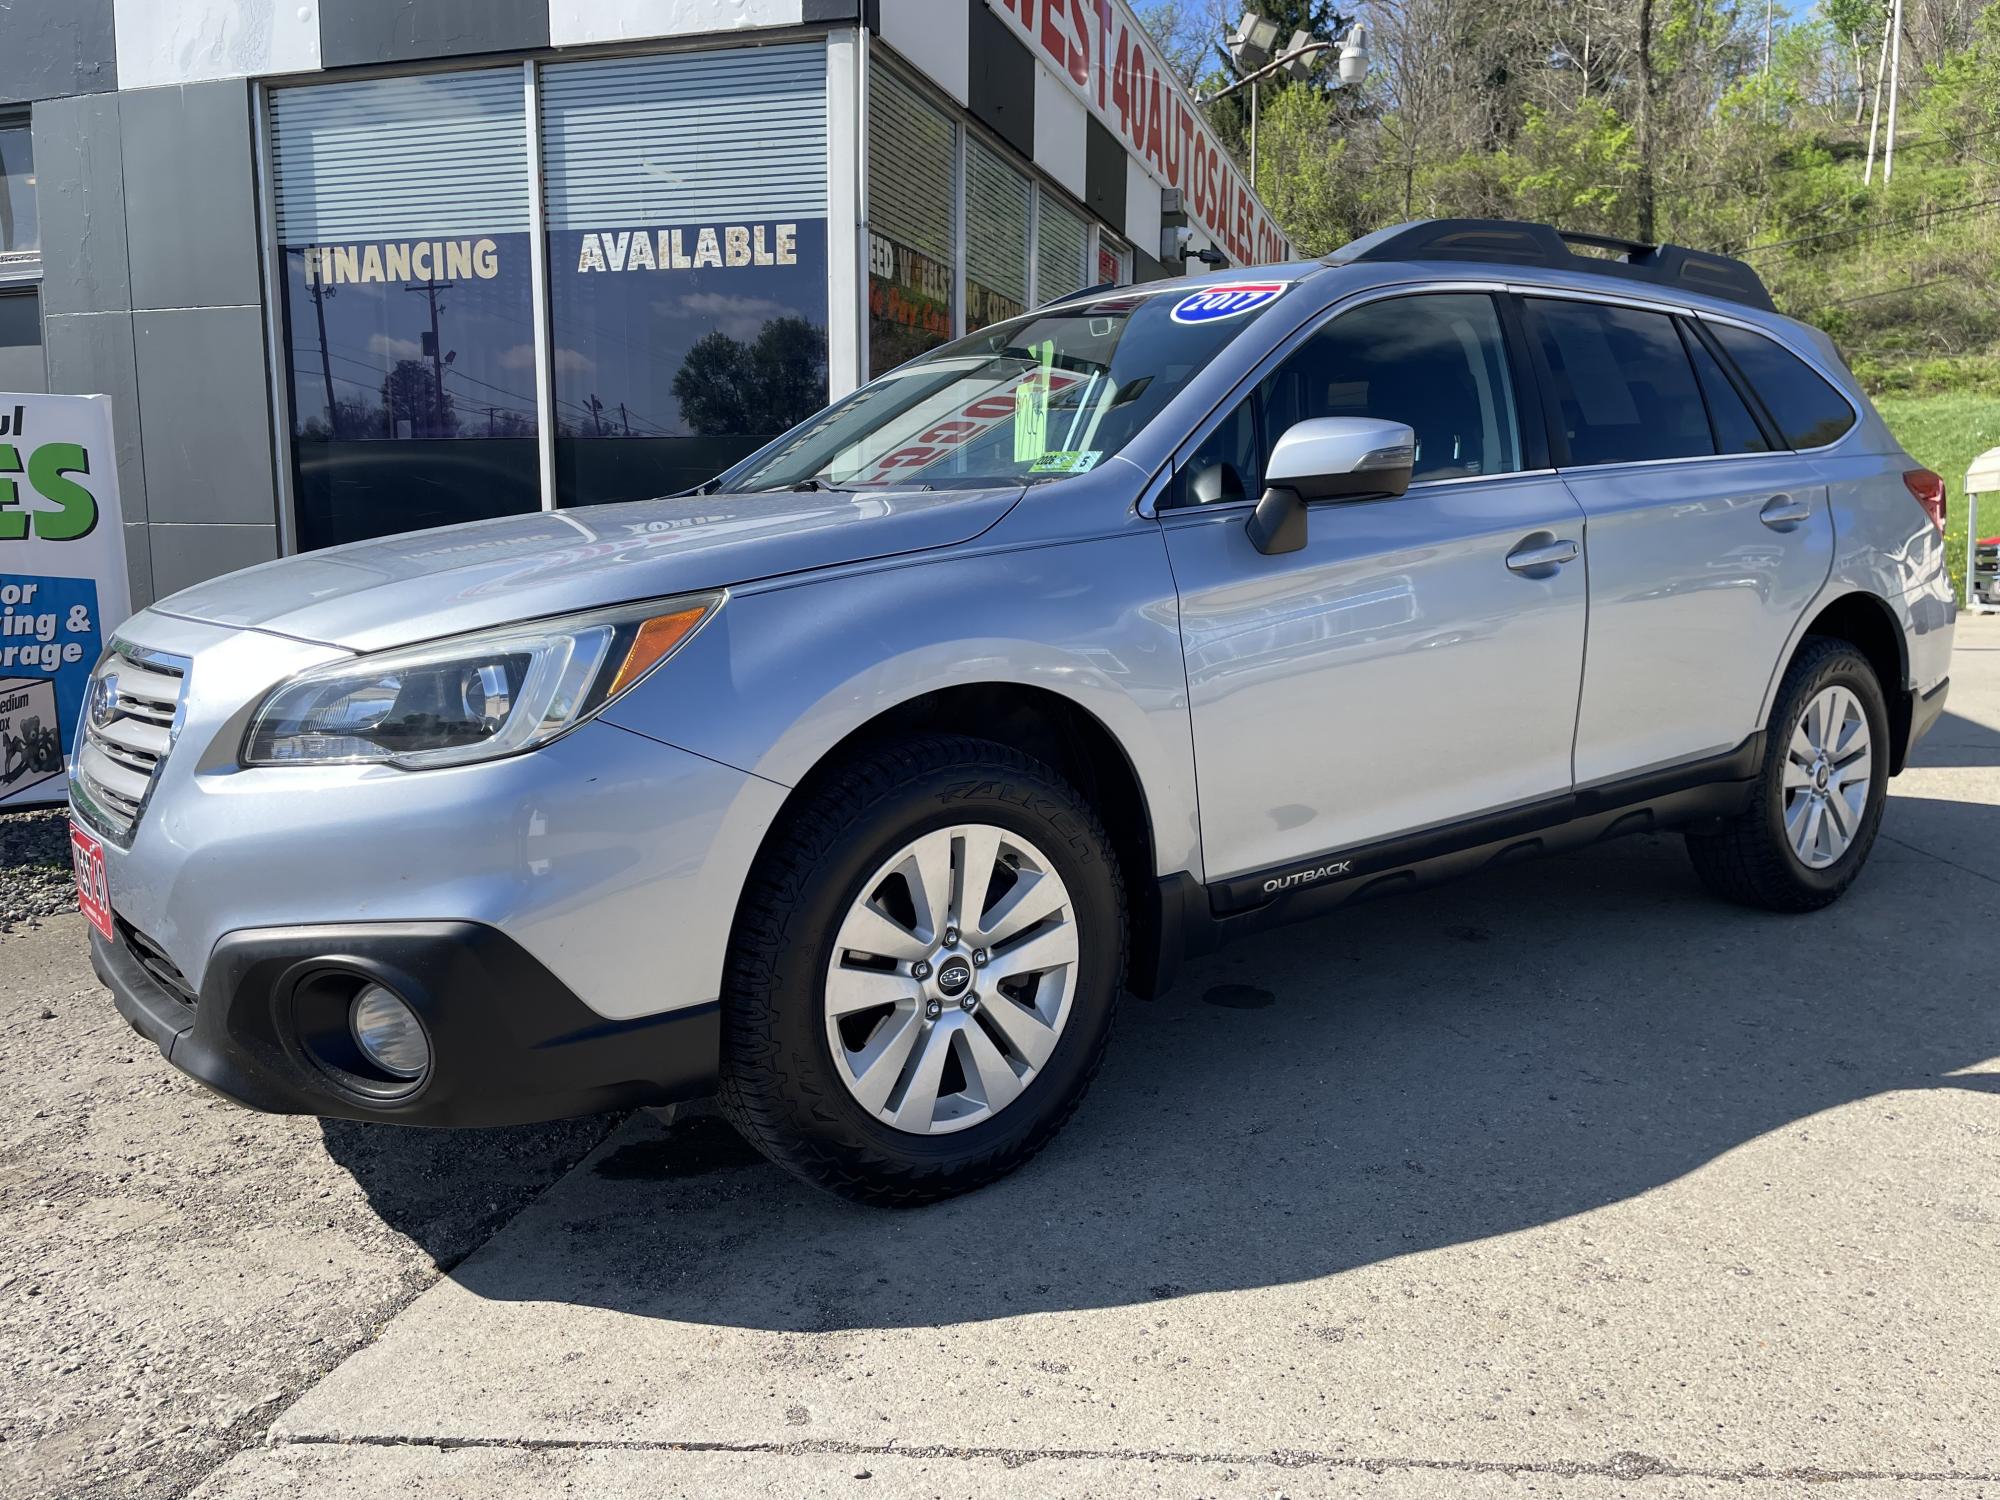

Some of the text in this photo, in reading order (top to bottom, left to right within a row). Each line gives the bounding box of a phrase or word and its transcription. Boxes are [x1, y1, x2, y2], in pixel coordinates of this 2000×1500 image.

[1001, 0, 1283, 267] EST40AUTOSALES.COM
[304, 223, 798, 286] FINANCING AVAILABLE
[868, 232, 894, 279] EED
[899, 246, 954, 306] WEELS?
[1181, 292, 1267, 312] 2017
[1079, 456, 1091, 467] 5
[0, 604, 92, 642] ing &
[0, 642, 83, 672] rage
[1263, 860, 1351, 893] OUTBACK
